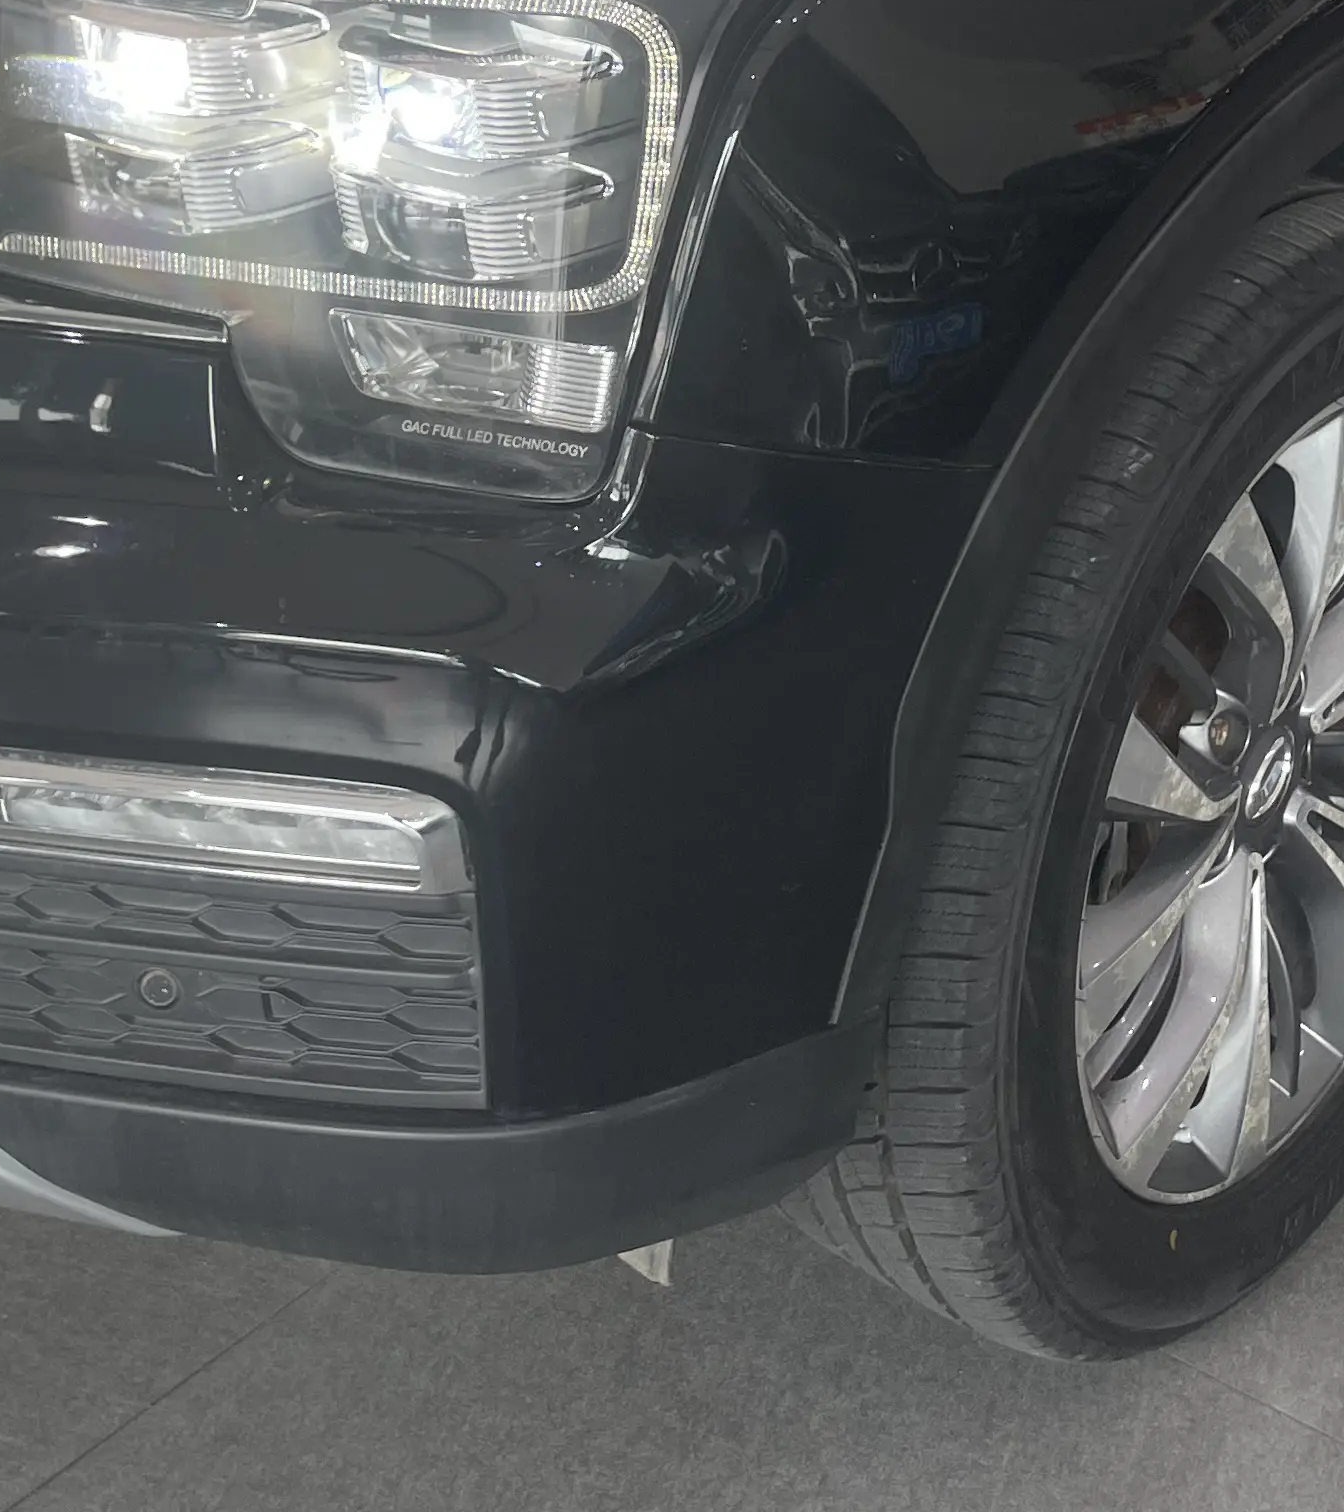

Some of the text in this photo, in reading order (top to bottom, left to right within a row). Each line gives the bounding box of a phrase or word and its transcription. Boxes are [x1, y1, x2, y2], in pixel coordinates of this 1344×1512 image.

[401, 419, 589, 458] GAC FULL LED TECHNOLOGY
